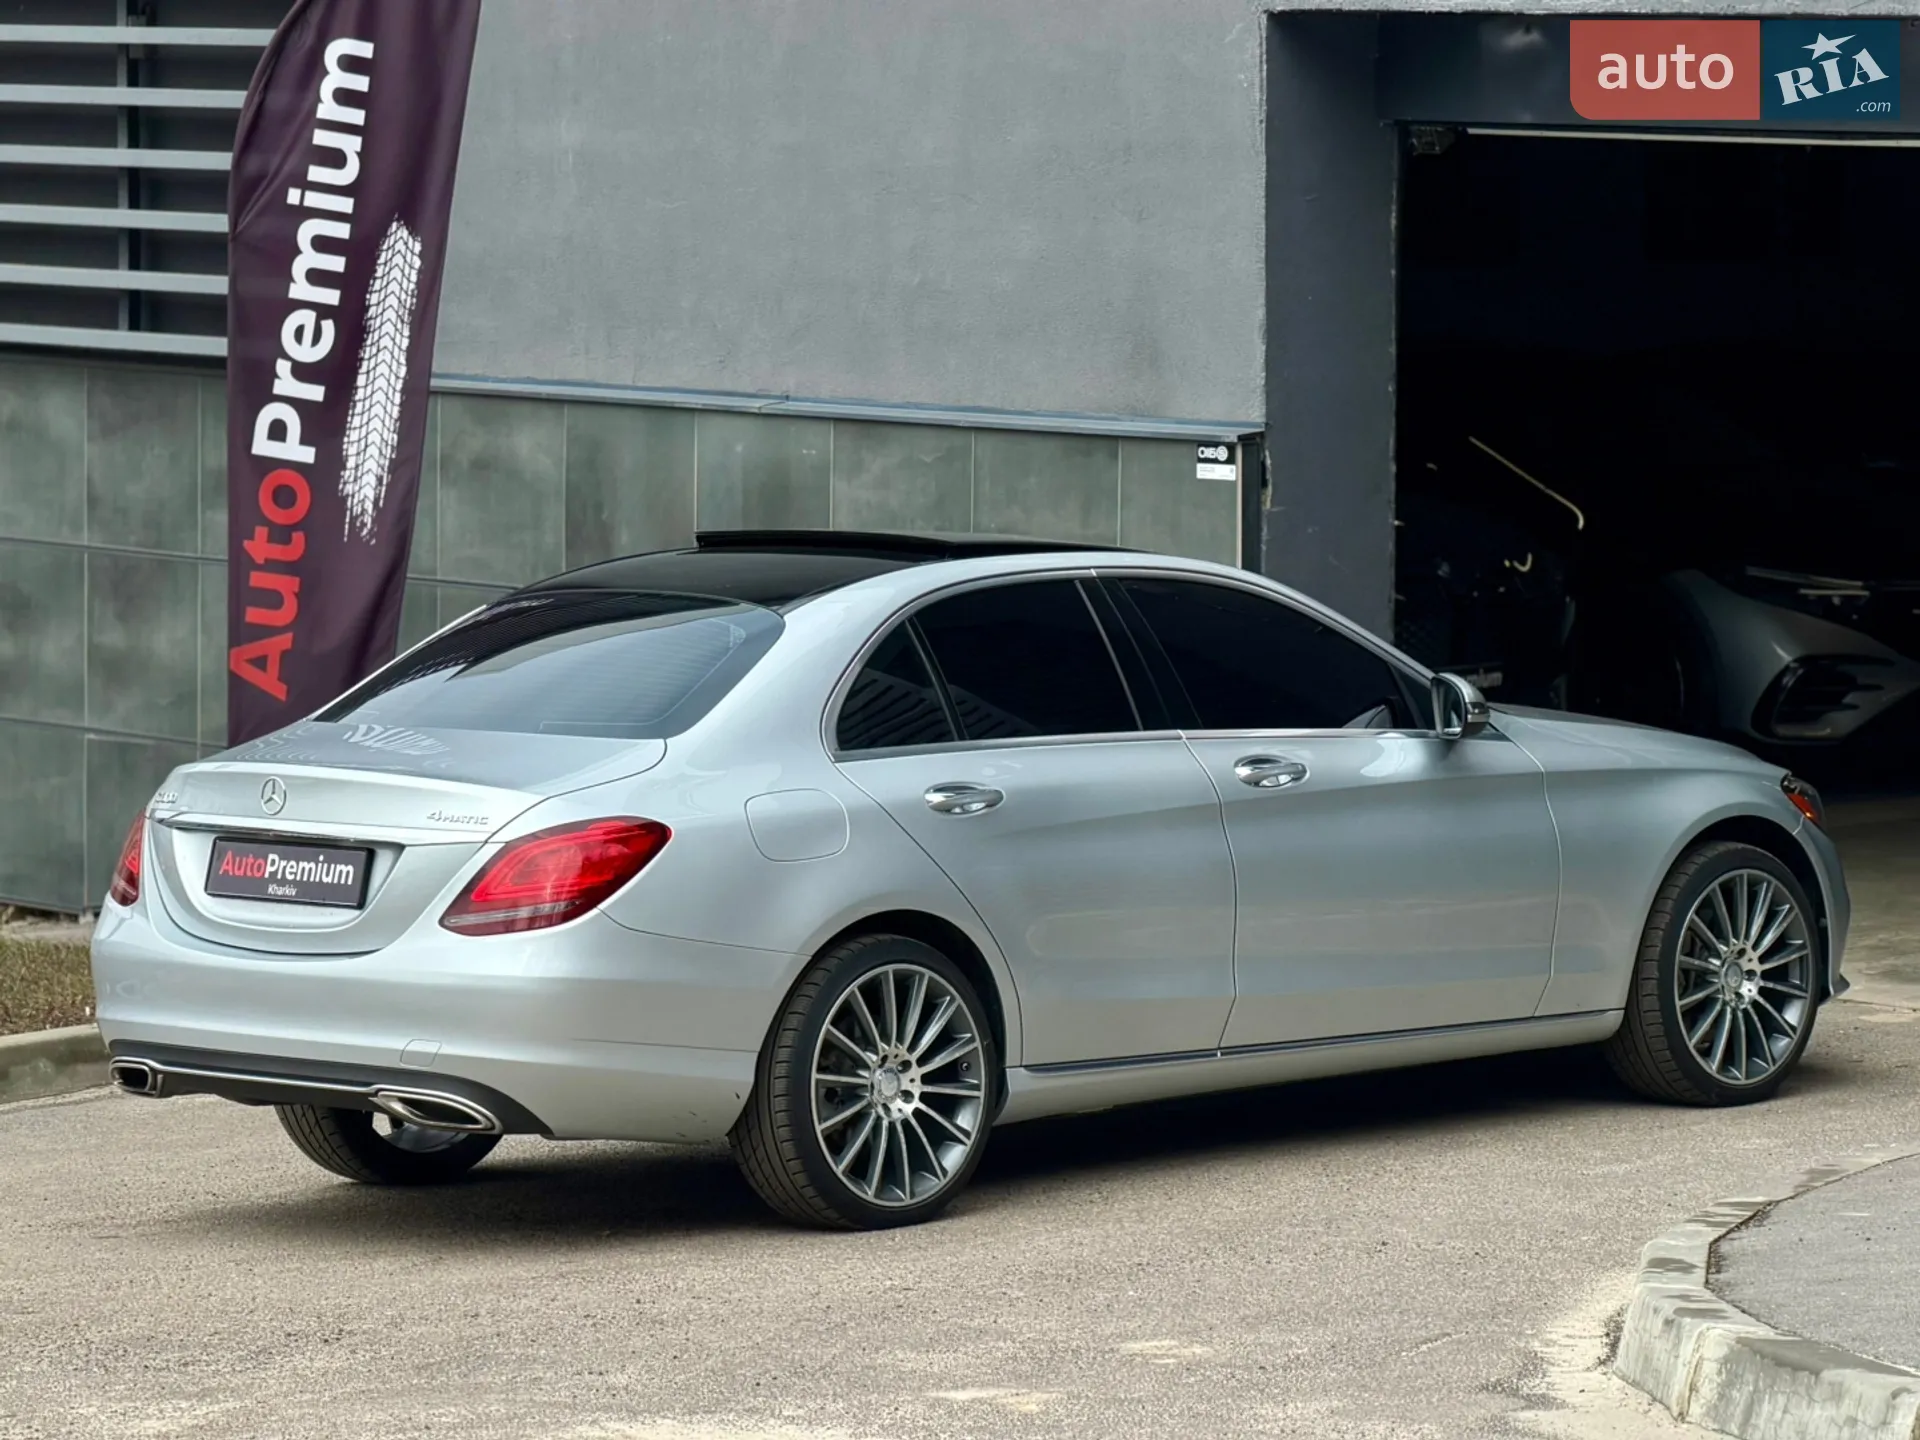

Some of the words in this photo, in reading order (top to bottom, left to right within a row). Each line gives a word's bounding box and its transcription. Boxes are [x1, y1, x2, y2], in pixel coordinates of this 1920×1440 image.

[229, 37, 374, 701] AutoPremium
[219, 850, 354, 885] AutoPremium
[267, 883, 297, 896] Kharkiv
